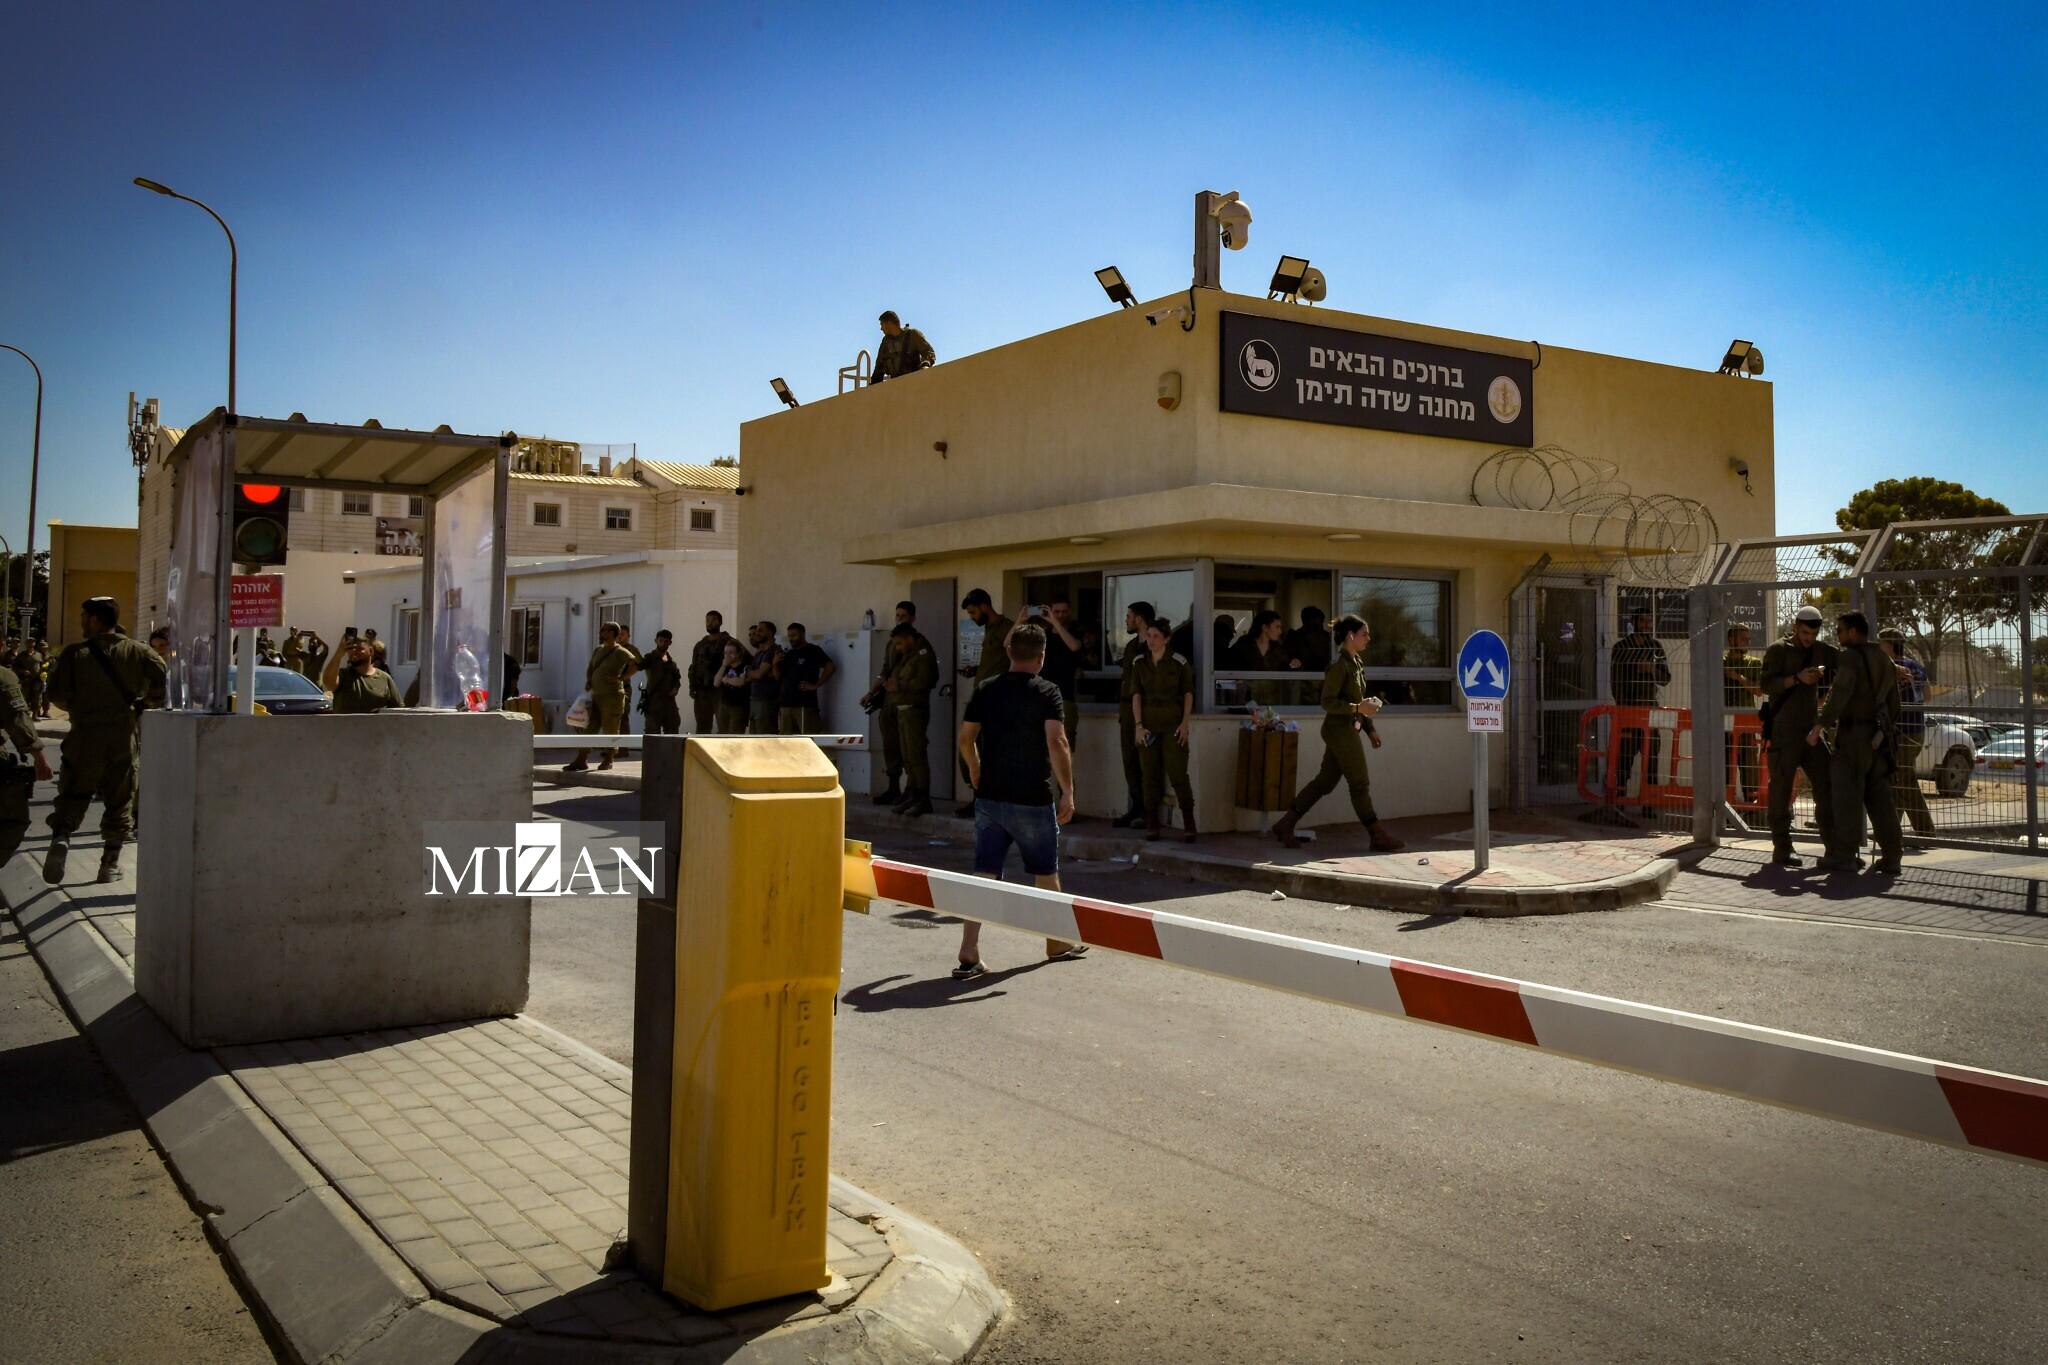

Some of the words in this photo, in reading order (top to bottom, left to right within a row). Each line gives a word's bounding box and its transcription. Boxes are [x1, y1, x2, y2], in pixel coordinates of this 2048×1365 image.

[1309, 346, 1385, 377] הבאים
[1392, 358, 1465, 389] ברוכים
[1295, 378, 1353, 406] תימן
[1361, 387, 1411, 413] שדה
[1418, 395, 1475, 422] מחנה
[232, 583, 271, 594] אזהרה
[1733, 605, 1756, 615] כניסת
[1472, 717, 1488, 726] השער
[1489, 716, 1499, 726] מול
